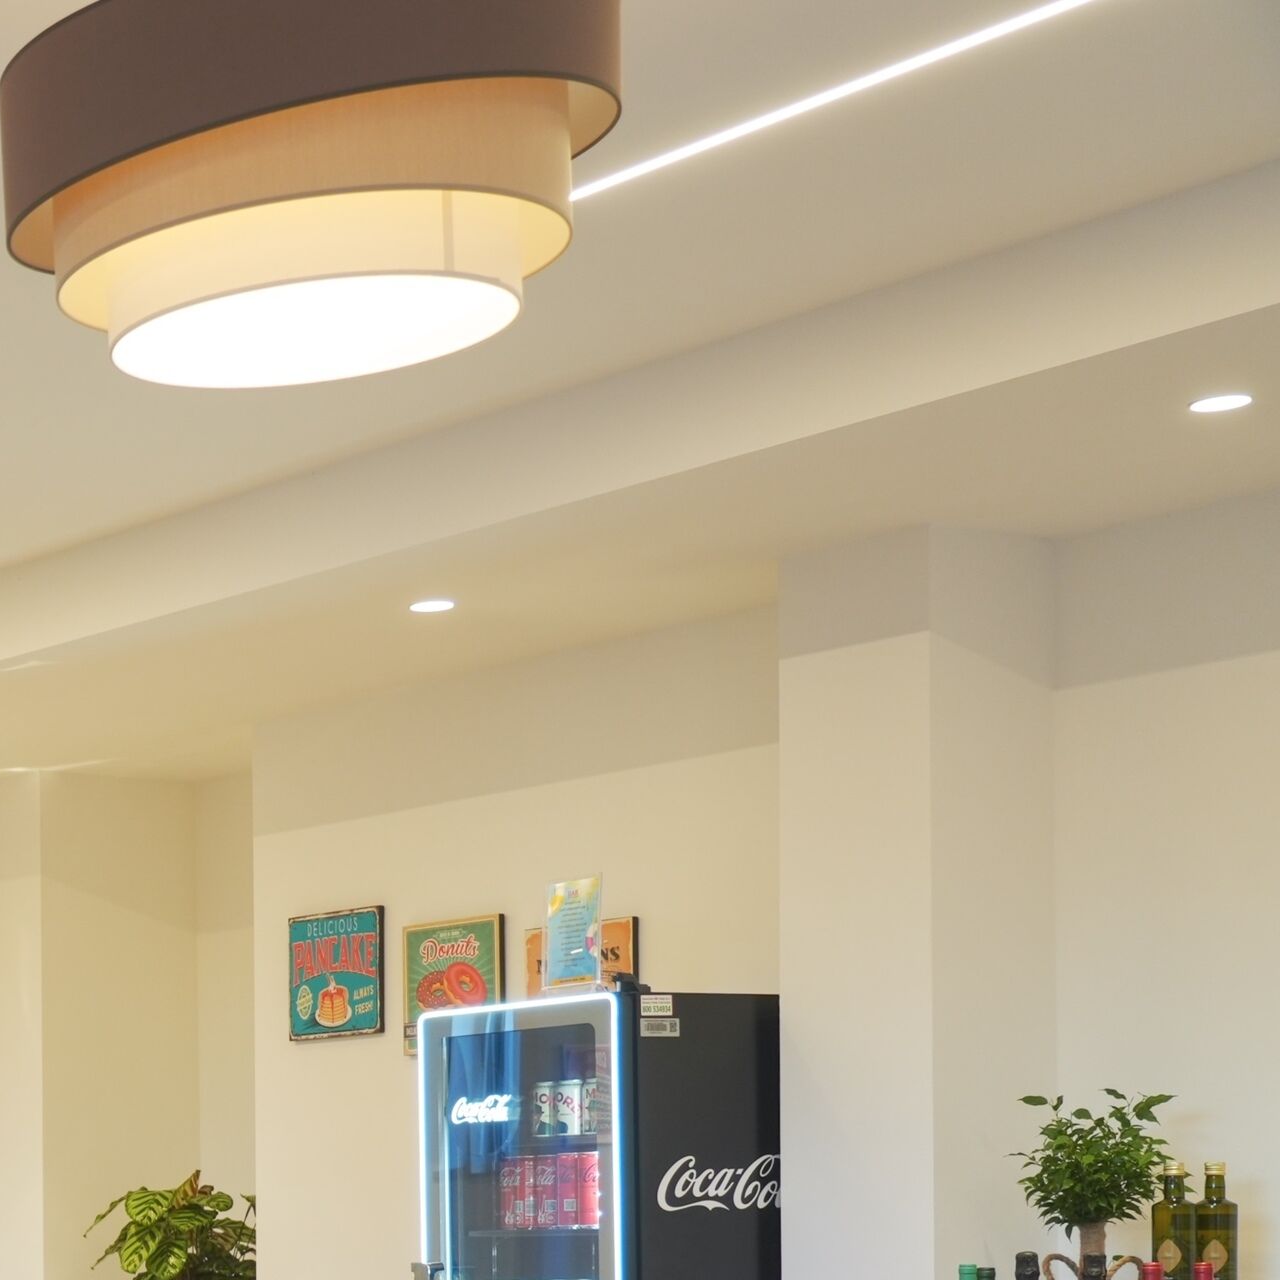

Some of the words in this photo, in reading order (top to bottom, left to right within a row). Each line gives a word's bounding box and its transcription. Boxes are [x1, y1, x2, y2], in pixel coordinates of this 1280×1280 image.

[307, 917, 358, 937] DELICIOUS
[292, 932, 377, 988] PANCAKE
[420, 934, 480, 965] Donuts
[354, 985, 374, 1000] ALWAYS
[451, 1094, 512, 1124] Coca-Cola
[657, 1154, 781, 1211] Coca-Co
